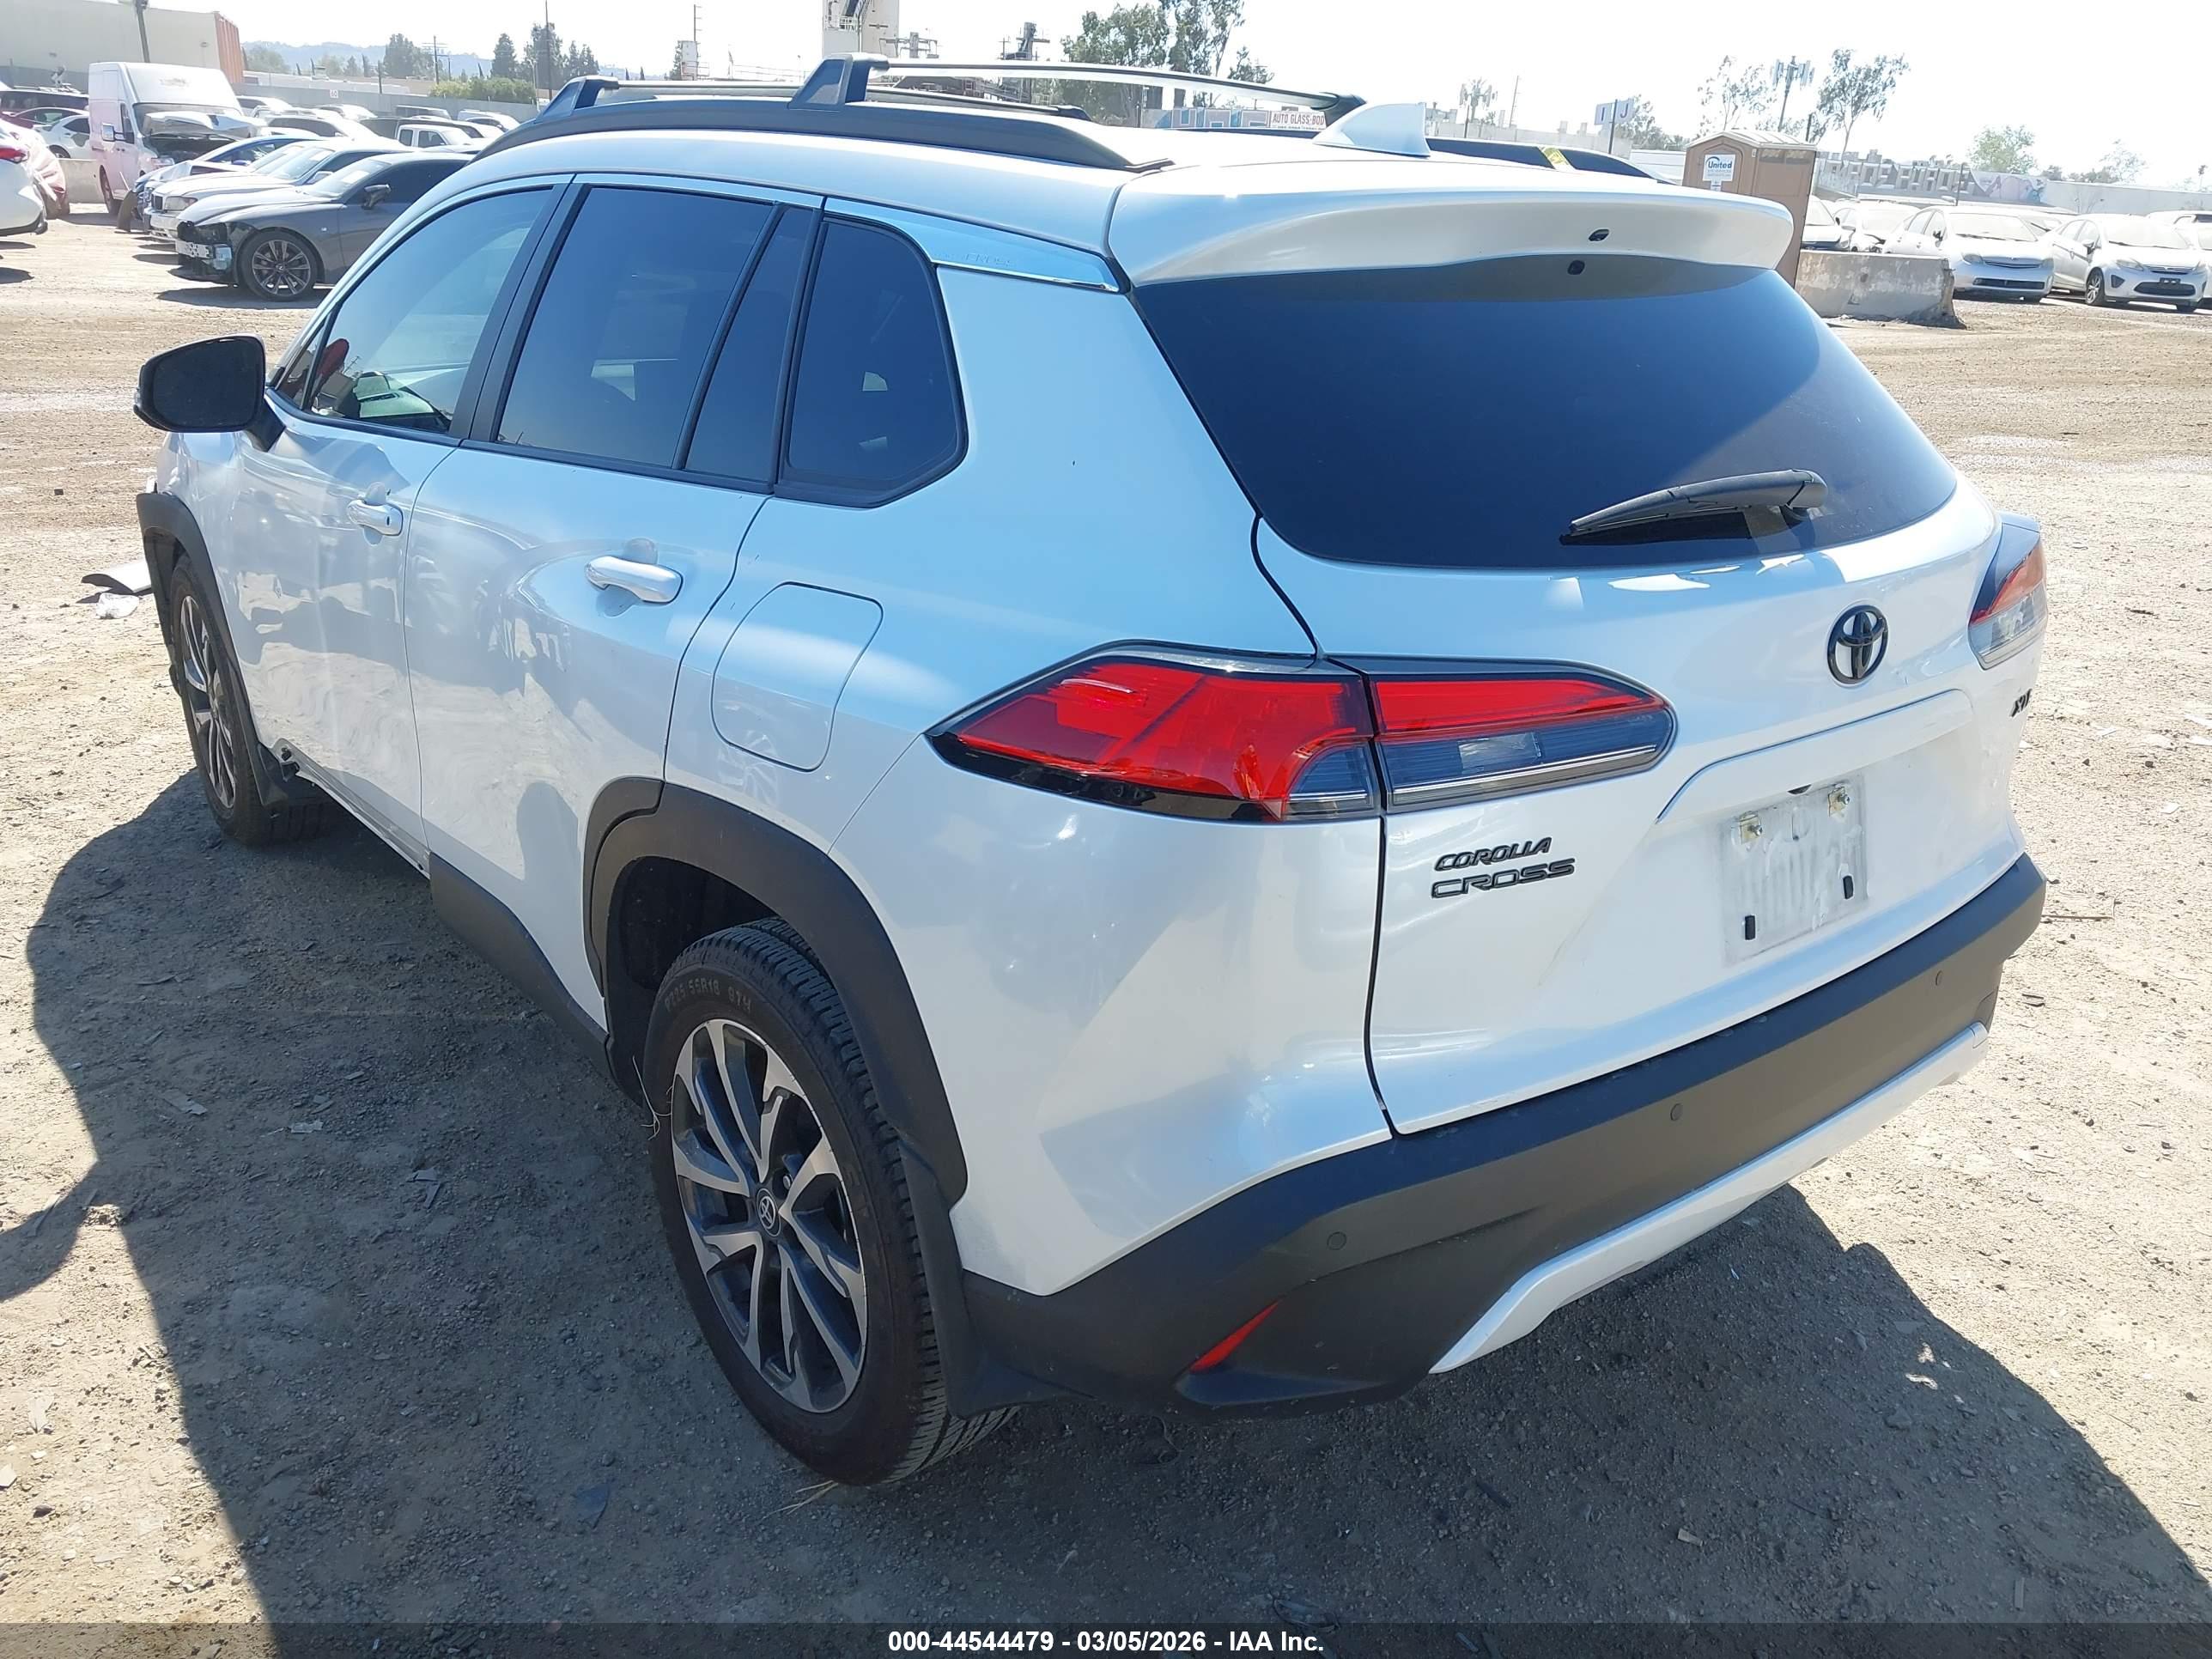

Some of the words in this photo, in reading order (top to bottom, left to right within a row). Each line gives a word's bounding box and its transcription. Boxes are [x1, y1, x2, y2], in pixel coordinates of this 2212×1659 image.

[1620, 103, 1629, 118] J
[1273, 113, 1289, 125] AUTO
[1707, 161, 1733, 169] United
[1434, 836, 1553, 872] COROLLA
[1431, 858, 1576, 899] CROSS
